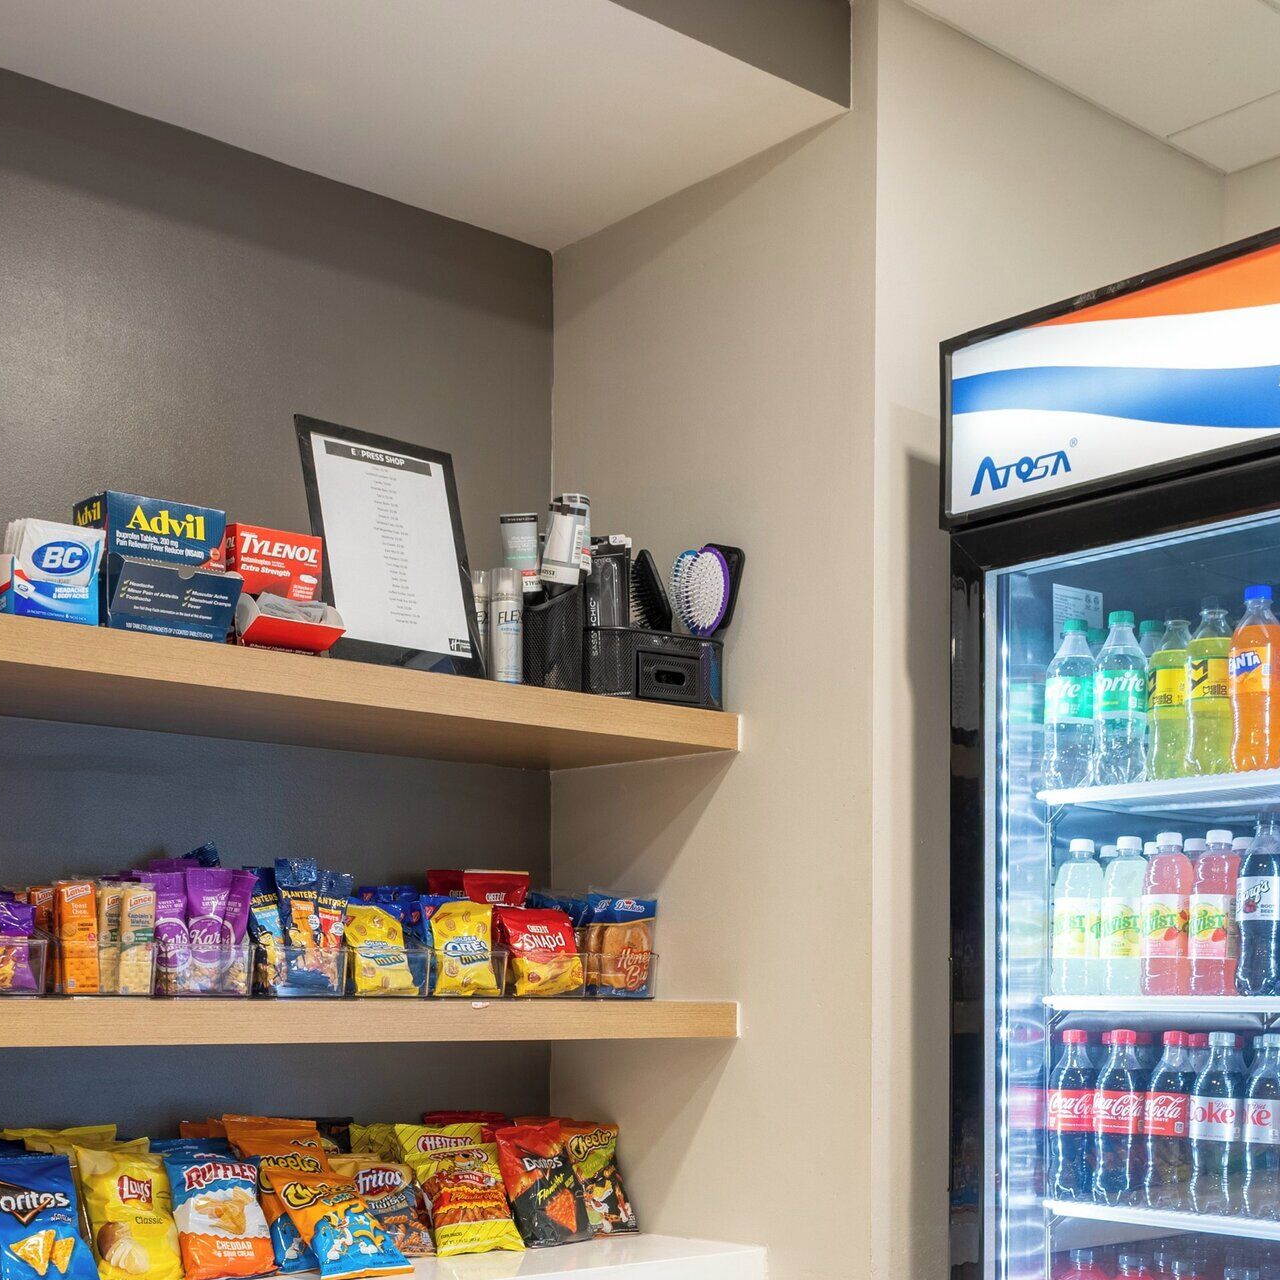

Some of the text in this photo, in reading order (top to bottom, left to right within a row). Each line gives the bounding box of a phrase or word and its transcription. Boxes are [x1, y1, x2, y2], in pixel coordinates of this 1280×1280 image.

[386, 456, 404, 466] SHOP
[75, 501, 101, 527] Advil
[126, 505, 205, 541] Advil
[116, 530, 179, 549] Ibuprofen Tablets, 200 mg
[116, 538, 127, 547] Pain
[128, 540, 164, 553] Reliever/Fever
[164, 547, 185, 556] Reducer
[240, 531, 319, 564] TYLENOL
[42, 546, 84, 568] BC
[241, 564, 291, 578] Extra Strength
[130, 581, 154, 589] Headache
[1094, 672, 1144, 692] Sprite
[66, 885, 90, 898] Lance
[282, 889, 318, 900] PLANTERS
[130, 896, 154, 906] Lance
[615, 902, 645, 913] Duchess
[461, 953, 491, 965] mini
[523, 1156, 563, 1172] Doritos
[184, 1162, 258, 1191] RUFFLES
[358, 1169, 402, 1194] Fritos
[120, 1176, 153, 1204] Lay's
[135, 1215, 163, 1226] Classic
[215, 1239, 253, 1251] CHEDDAR
[223, 1249, 237, 1258] SOUR
[237, 1250, 255, 1258] CREAM
